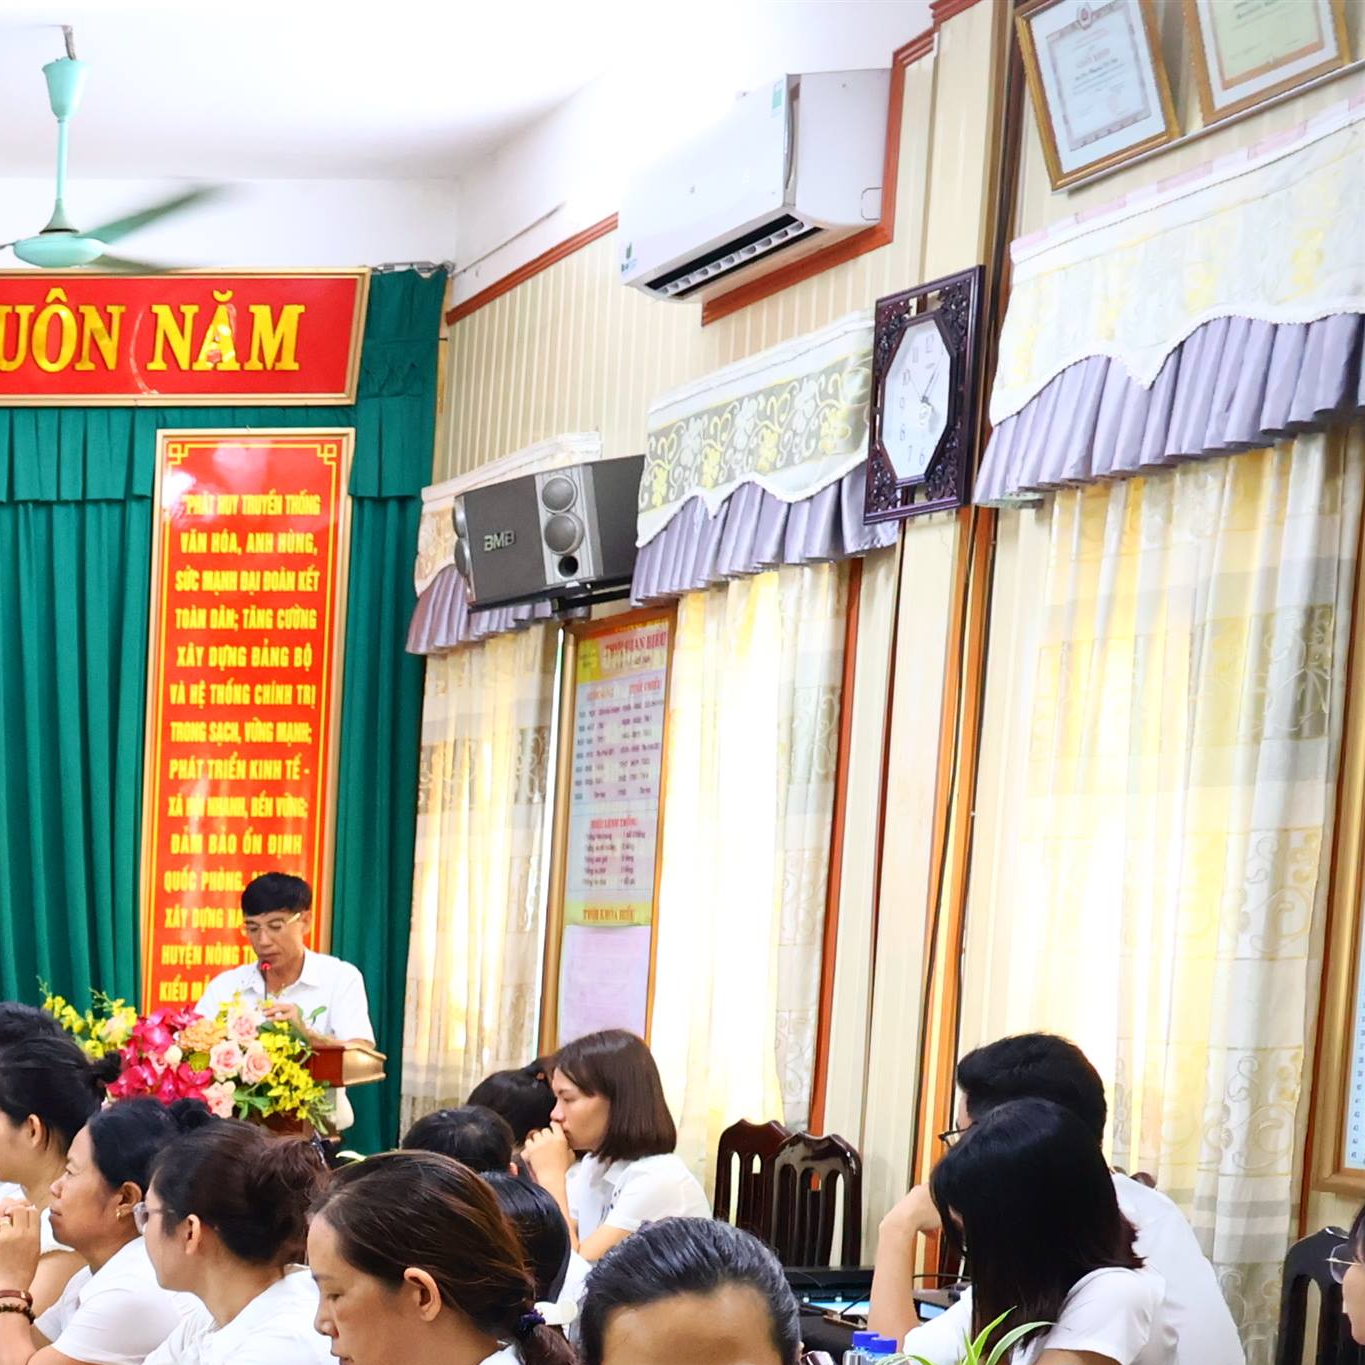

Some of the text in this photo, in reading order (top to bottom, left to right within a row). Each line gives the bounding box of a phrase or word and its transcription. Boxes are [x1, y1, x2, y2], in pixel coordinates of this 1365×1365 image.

[146, 290, 306, 371] NĂM
[483, 529, 516, 551] BMB
[175, 565, 320, 595] SỨC MẠNH ĐẠI ĐOÀN KẾT
[175, 605, 206, 628] TOÀN
[243, 605, 273, 629] TĂNG
[277, 604, 317, 629] CƯỜNG
[177, 638, 312, 671] XÂY DỰNG ĐẢNG BỘ
[170, 678, 316, 709] VÀ HỆ THỐNG CHÍNH TRỊ
[169, 755, 204, 779] PHÁT
[208, 752, 246, 779] TRIỂN
[250, 760, 282, 780] KINH
[286, 753, 301, 780] TẾ
